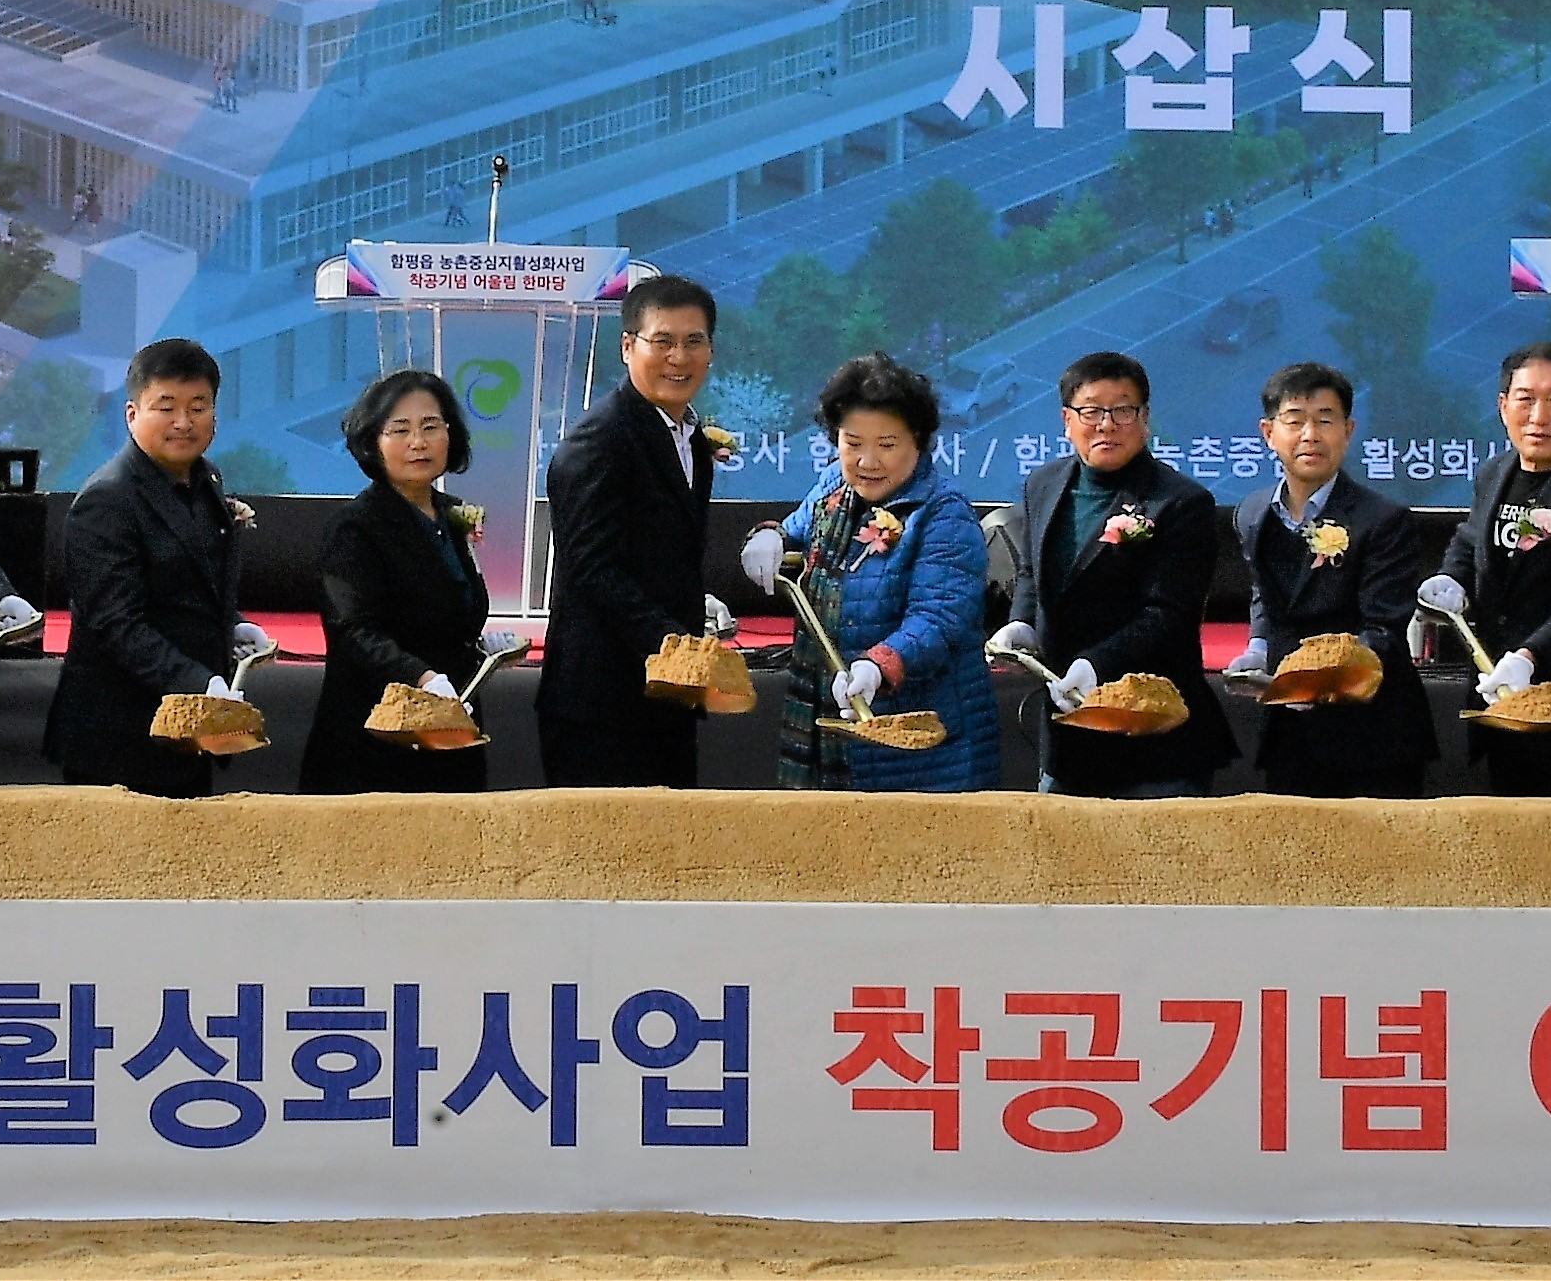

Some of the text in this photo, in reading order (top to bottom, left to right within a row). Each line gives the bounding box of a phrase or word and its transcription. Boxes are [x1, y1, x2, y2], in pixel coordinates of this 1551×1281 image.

[942, 3, 1412, 135] 시삽식
[391, 253, 585, 272] 함평읍 농촌중심지활성화사업
[409, 272, 566, 291] 착공기념 어울림 한마당
[1151, 434, 1286, 478] 농촌중
[824, 985, 1448, 1153] 착공기념
